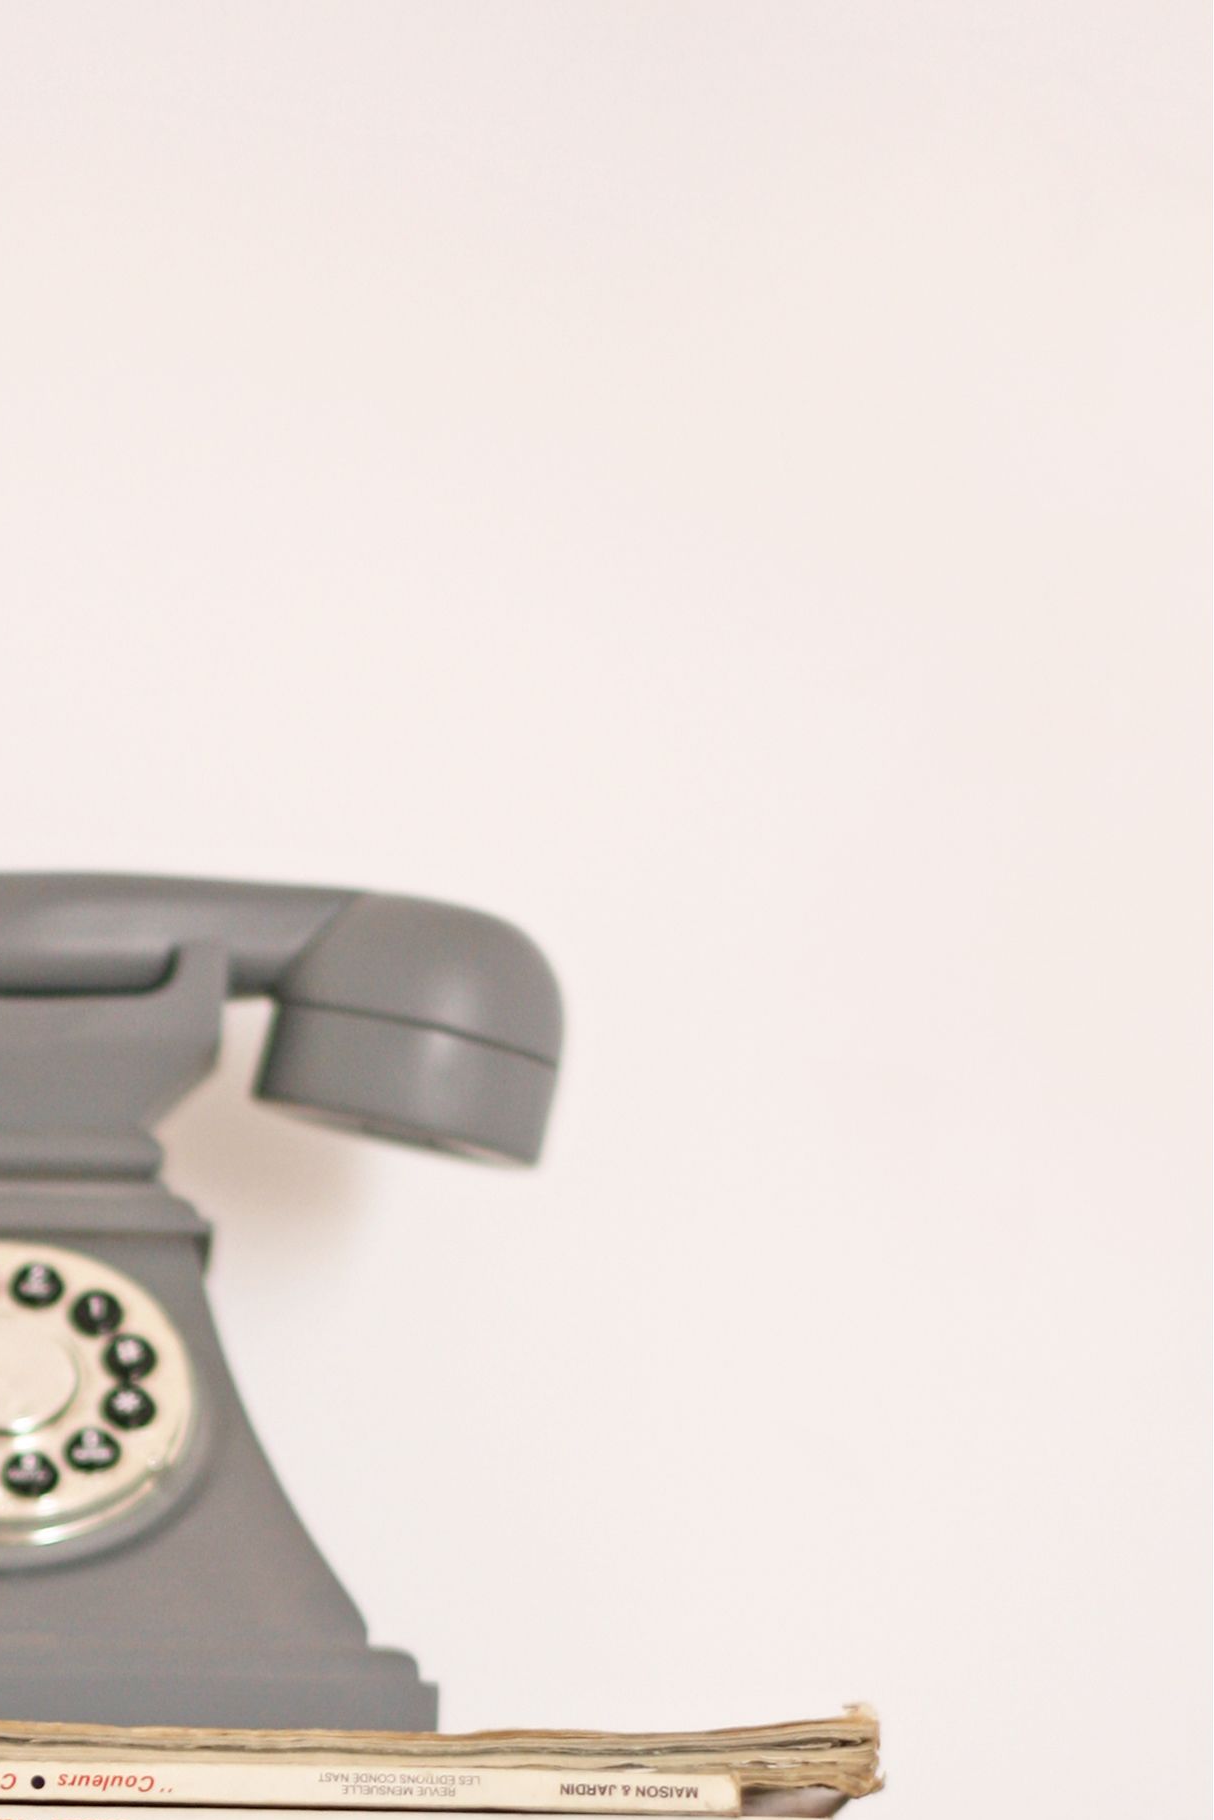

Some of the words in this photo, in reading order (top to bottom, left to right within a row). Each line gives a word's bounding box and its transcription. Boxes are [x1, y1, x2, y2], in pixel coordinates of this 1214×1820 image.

[318, 1772, 349, 1783] NAST
[458, 1775, 481, 1786] LES
[341, 1785, 413, 1796] MENSUELLE
[417, 1786, 456, 1797] REVUE
[559, 1783, 617, 1796] JARDIN
[620, 1785, 631, 1796] &
[636, 1785, 698, 1799] MAISON
